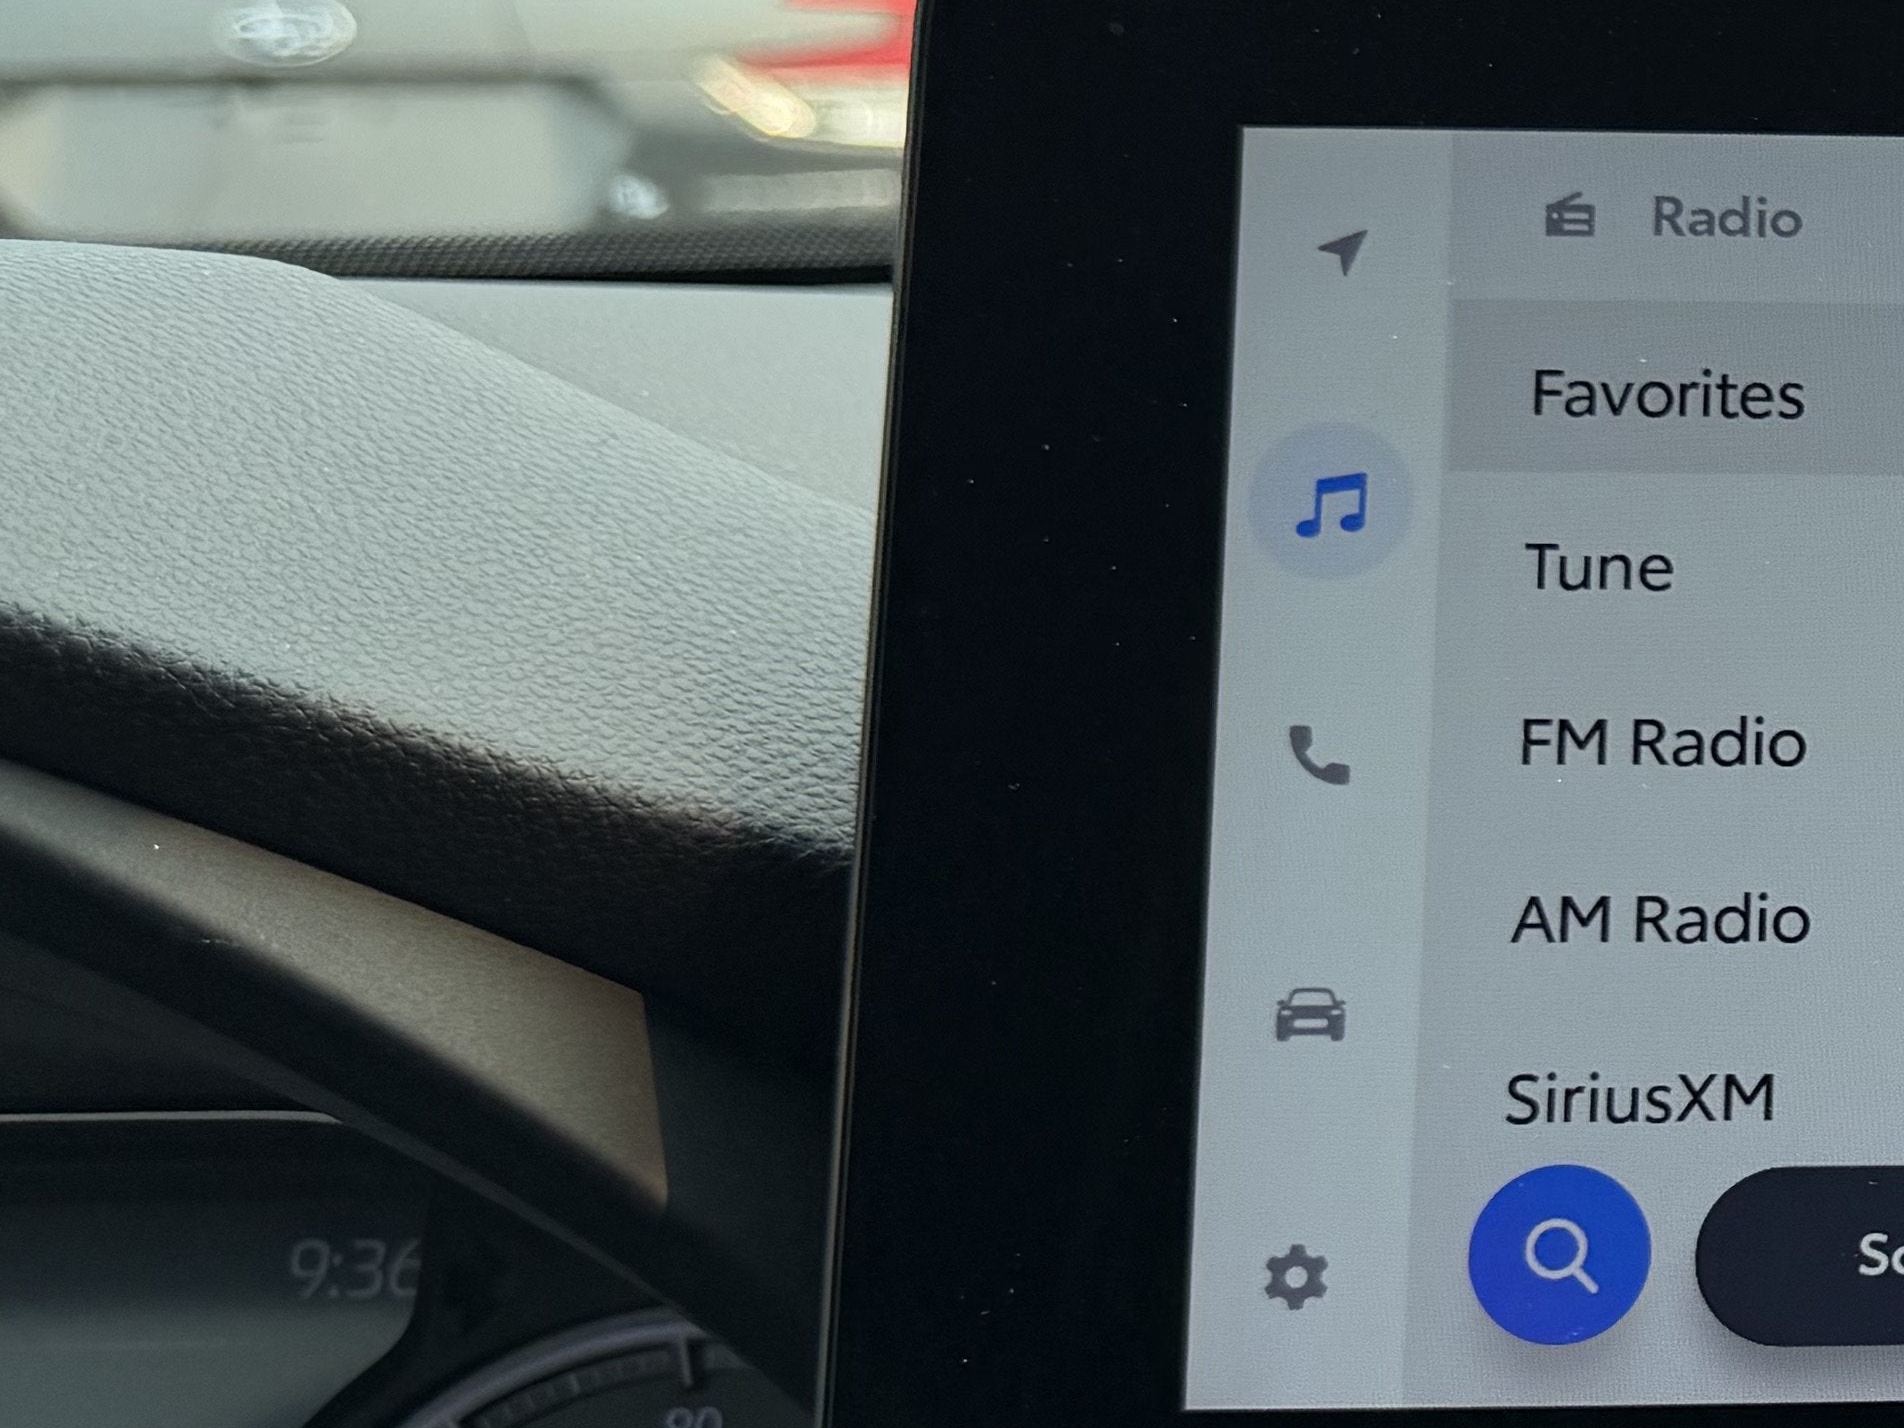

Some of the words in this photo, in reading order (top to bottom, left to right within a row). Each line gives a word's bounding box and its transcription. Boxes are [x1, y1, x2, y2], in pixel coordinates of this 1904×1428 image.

[1654, 195, 1802, 237] Radio
[1534, 369, 1804, 419] Favorites
[1525, 543, 1673, 591] Tune
[1522, 719, 1607, 765] FM
[1632, 716, 1806, 767] Radio
[1511, 896, 1610, 943] AM
[1635, 892, 1810, 944] Radio
[1506, 1072, 1773, 1125] SiriusXM
[291, 1239, 420, 1300] 9:36
